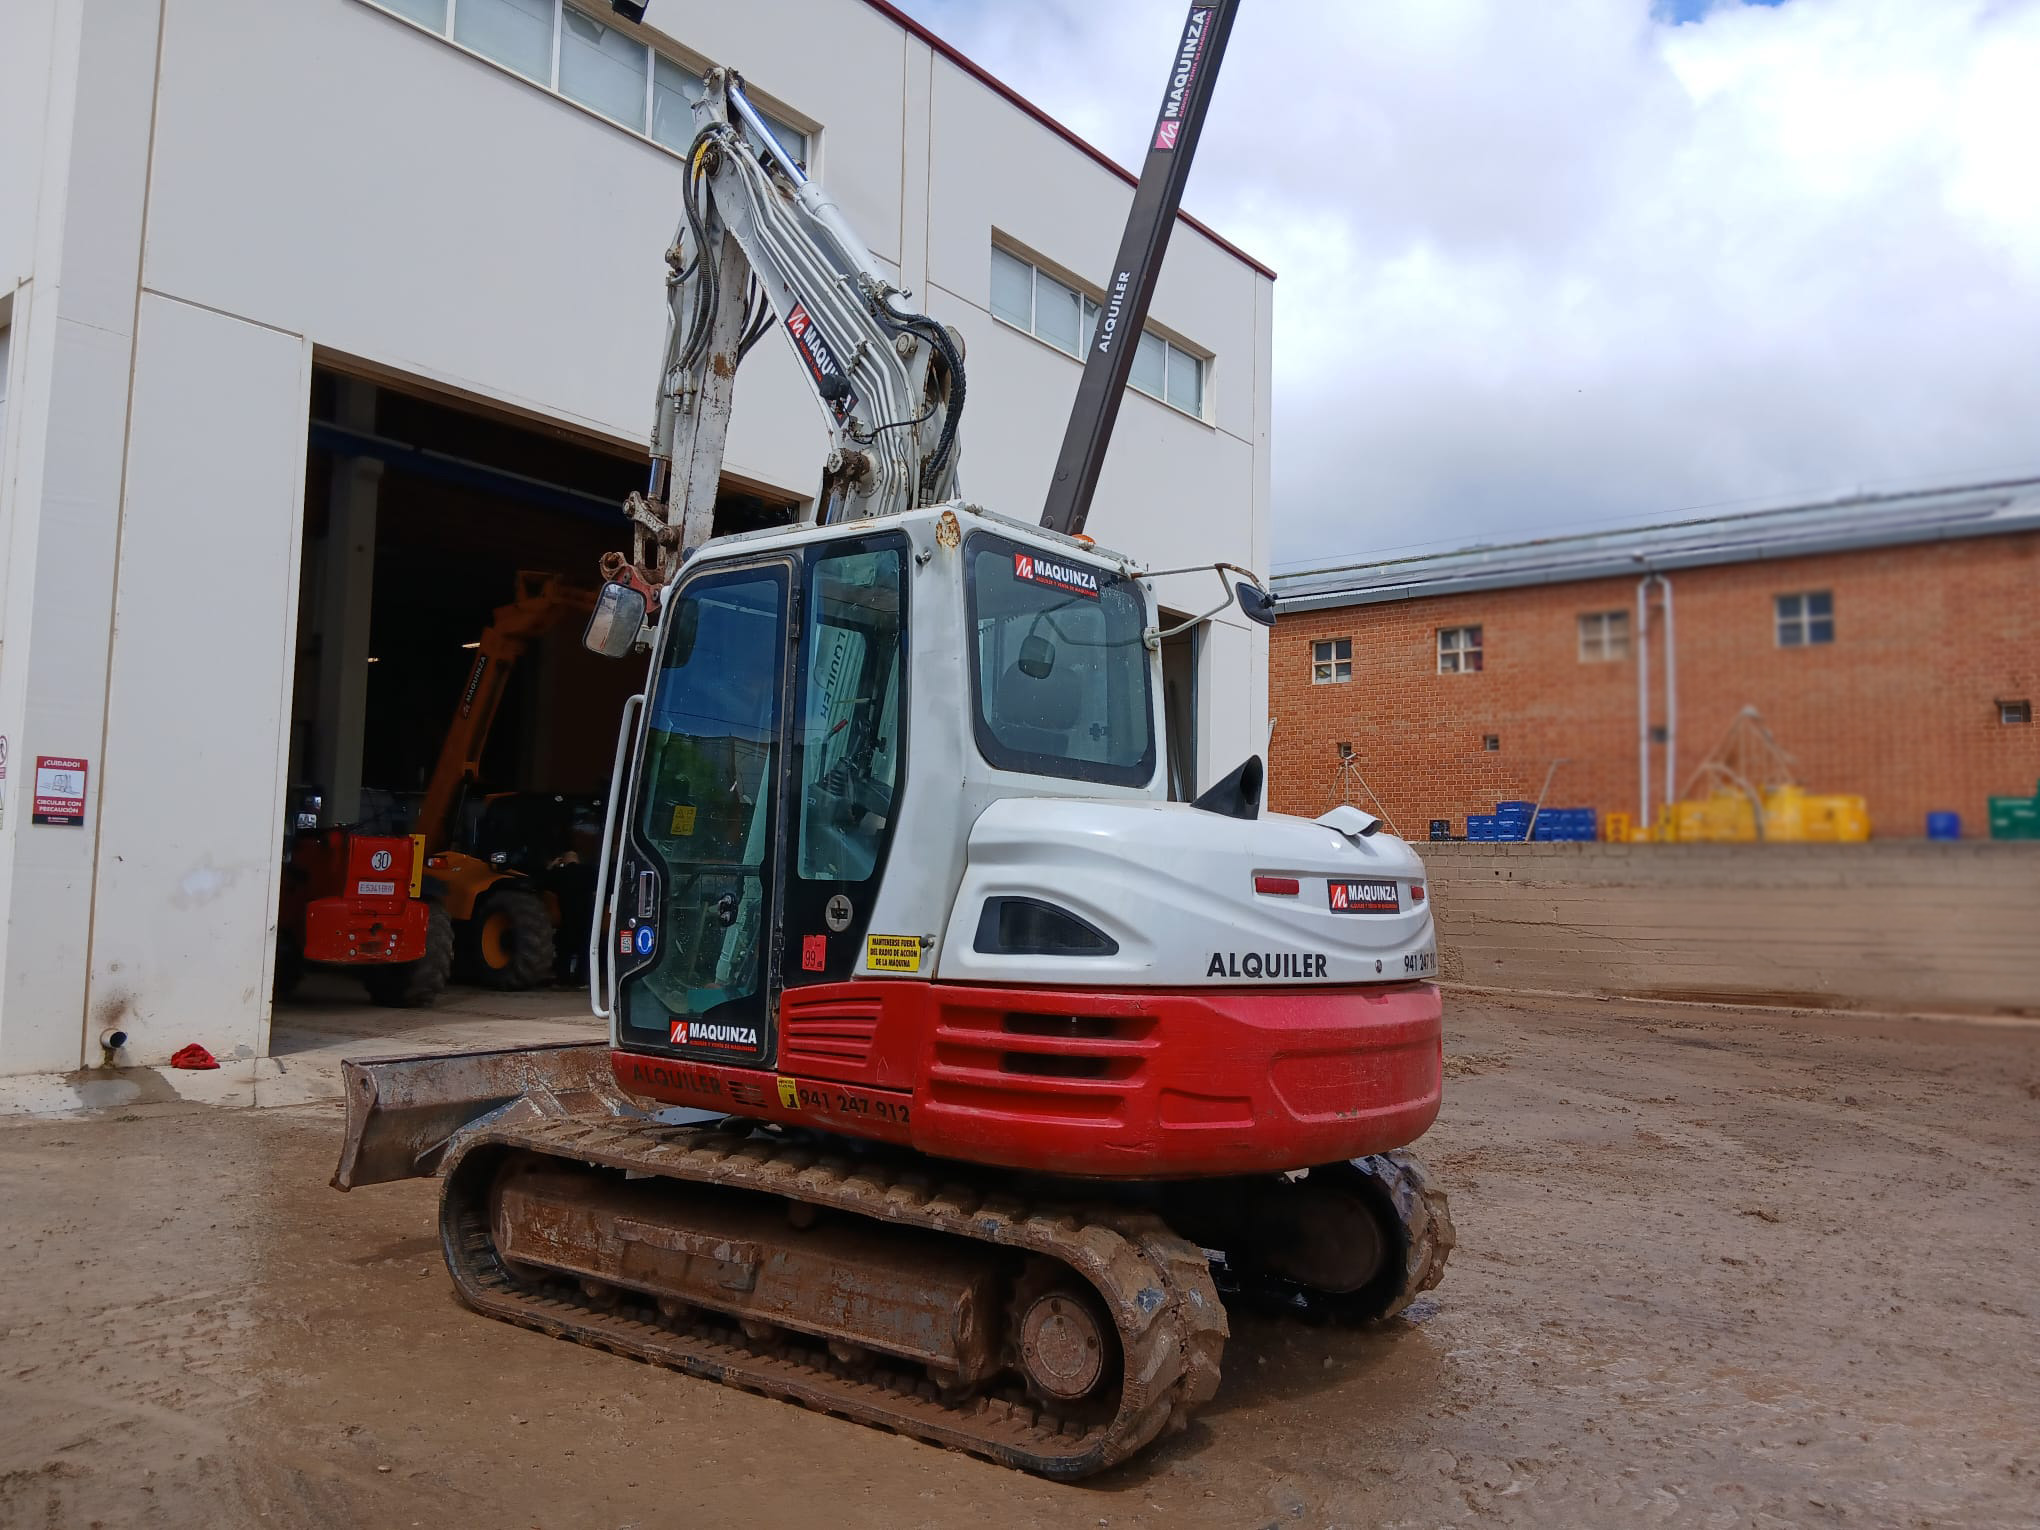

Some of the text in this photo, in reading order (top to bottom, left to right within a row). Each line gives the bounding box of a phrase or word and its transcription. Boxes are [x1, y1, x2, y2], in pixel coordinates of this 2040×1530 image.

[1165, 10, 1207, 118] MAQUINZA
[1099, 271, 1130, 353] ALQUILER
[1034, 560, 1098, 590] MAQUINZA
[375, 852, 389, 869] 30
[1348, 885, 1397, 901] MAQUINZA
[879, 948, 892, 956] RADIO
[901, 939, 916, 947] FUERA
[805, 950, 816, 967] 99
[1206, 952, 1328, 978] ALQUILER
[1404, 954, 1418, 972] 941
[689, 1023, 757, 1044] MAQUINZA
[633, 1064, 723, 1096] ALQUILER
[799, 1089, 910, 1123] 941 247 912
